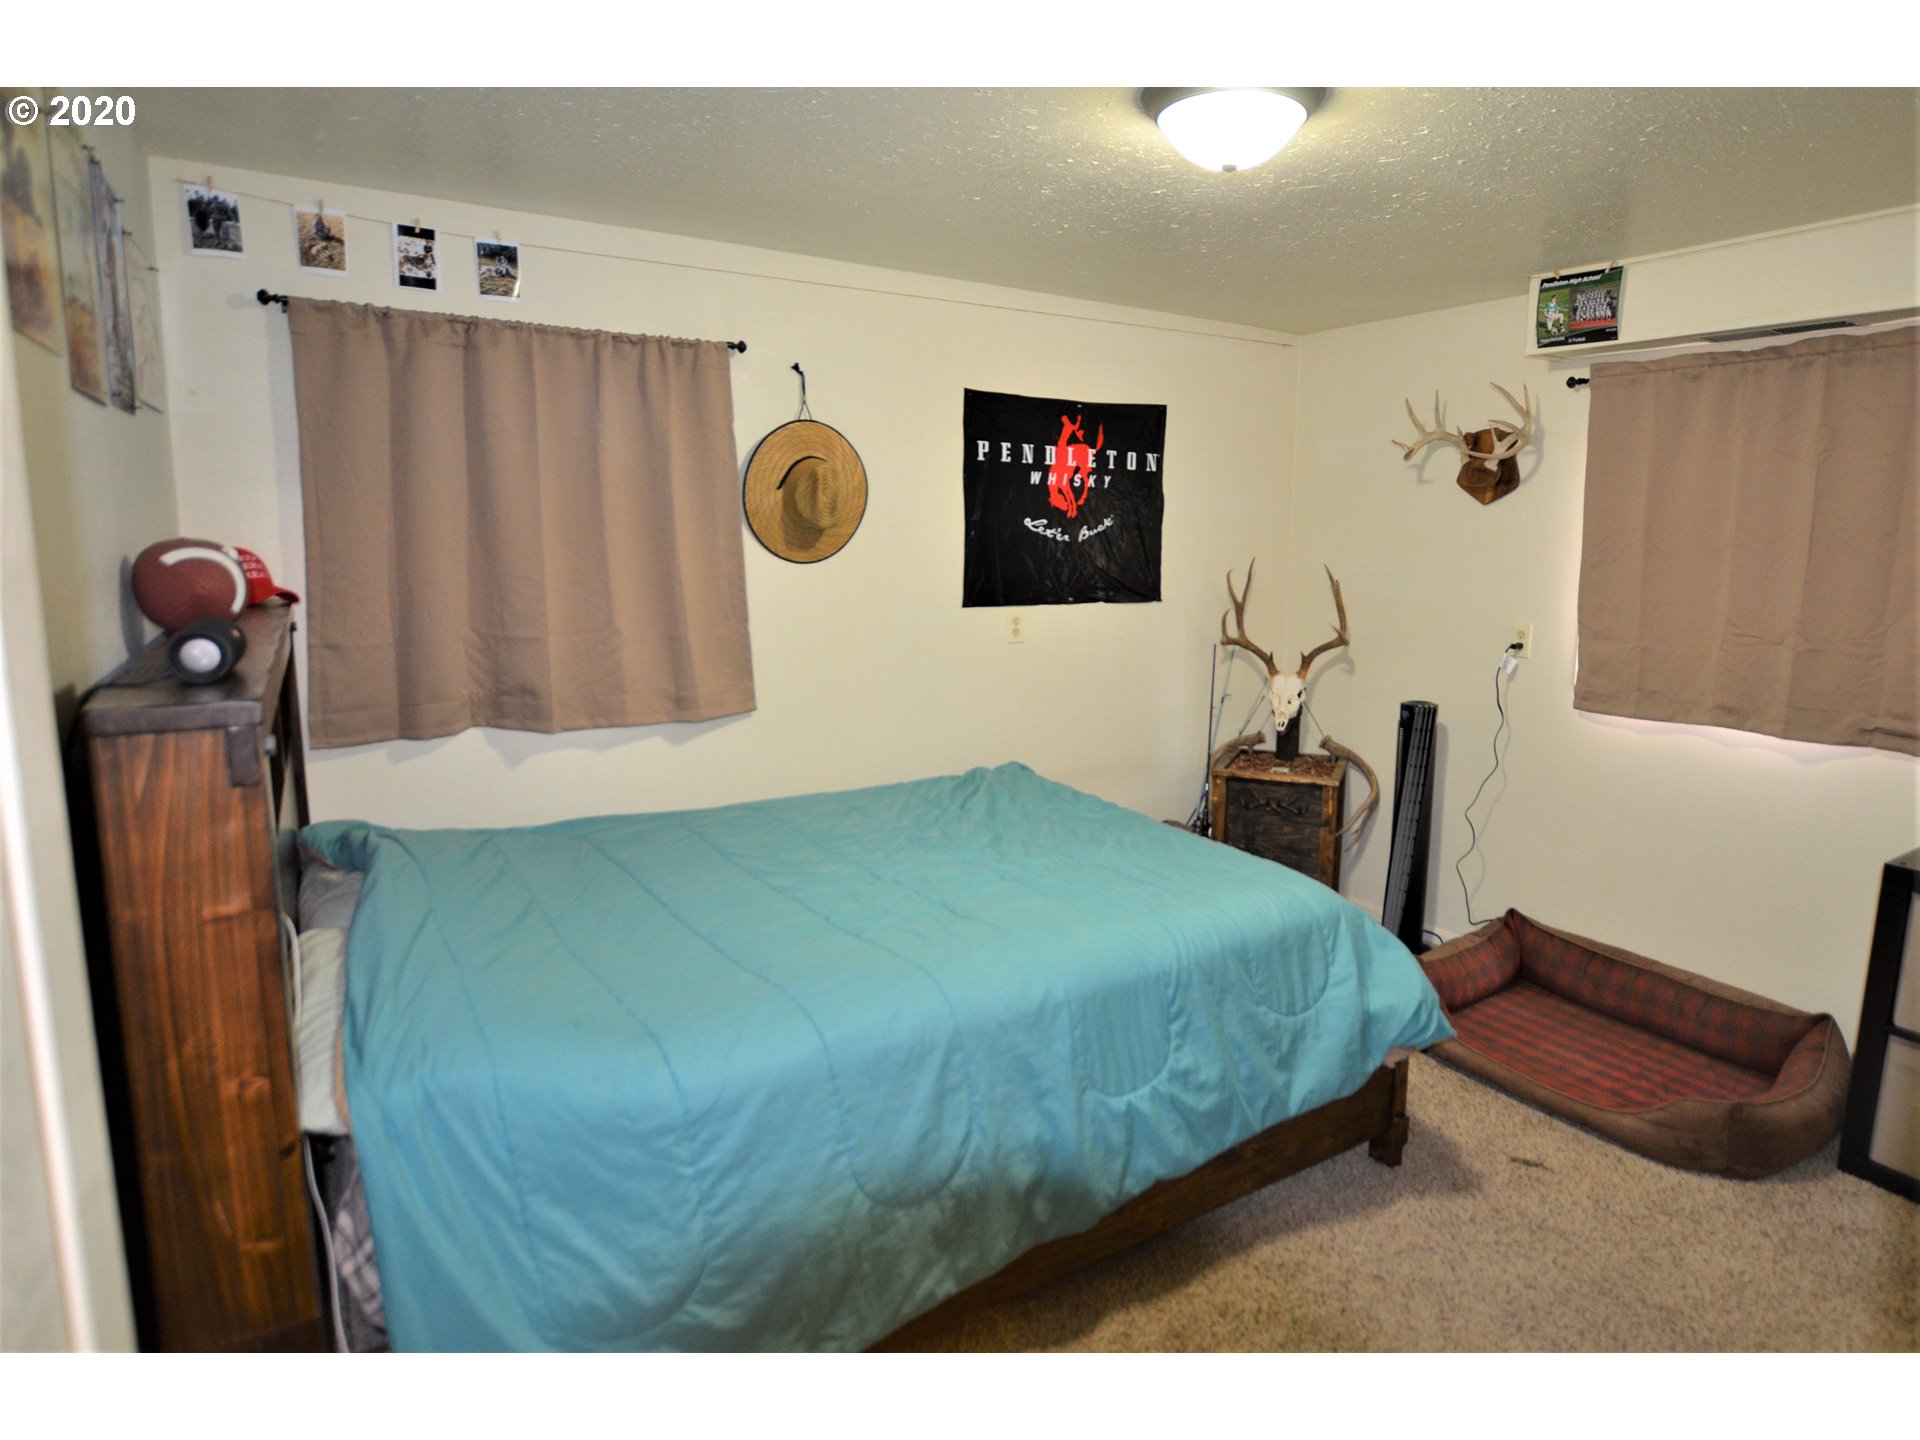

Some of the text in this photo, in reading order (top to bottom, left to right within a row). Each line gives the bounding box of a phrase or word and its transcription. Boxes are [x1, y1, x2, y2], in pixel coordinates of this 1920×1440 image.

[976, 440, 1159, 472] PENDLETON
[1029, 471, 1112, 489] WHISKY
[1078, 516, 1114, 543] Buck
